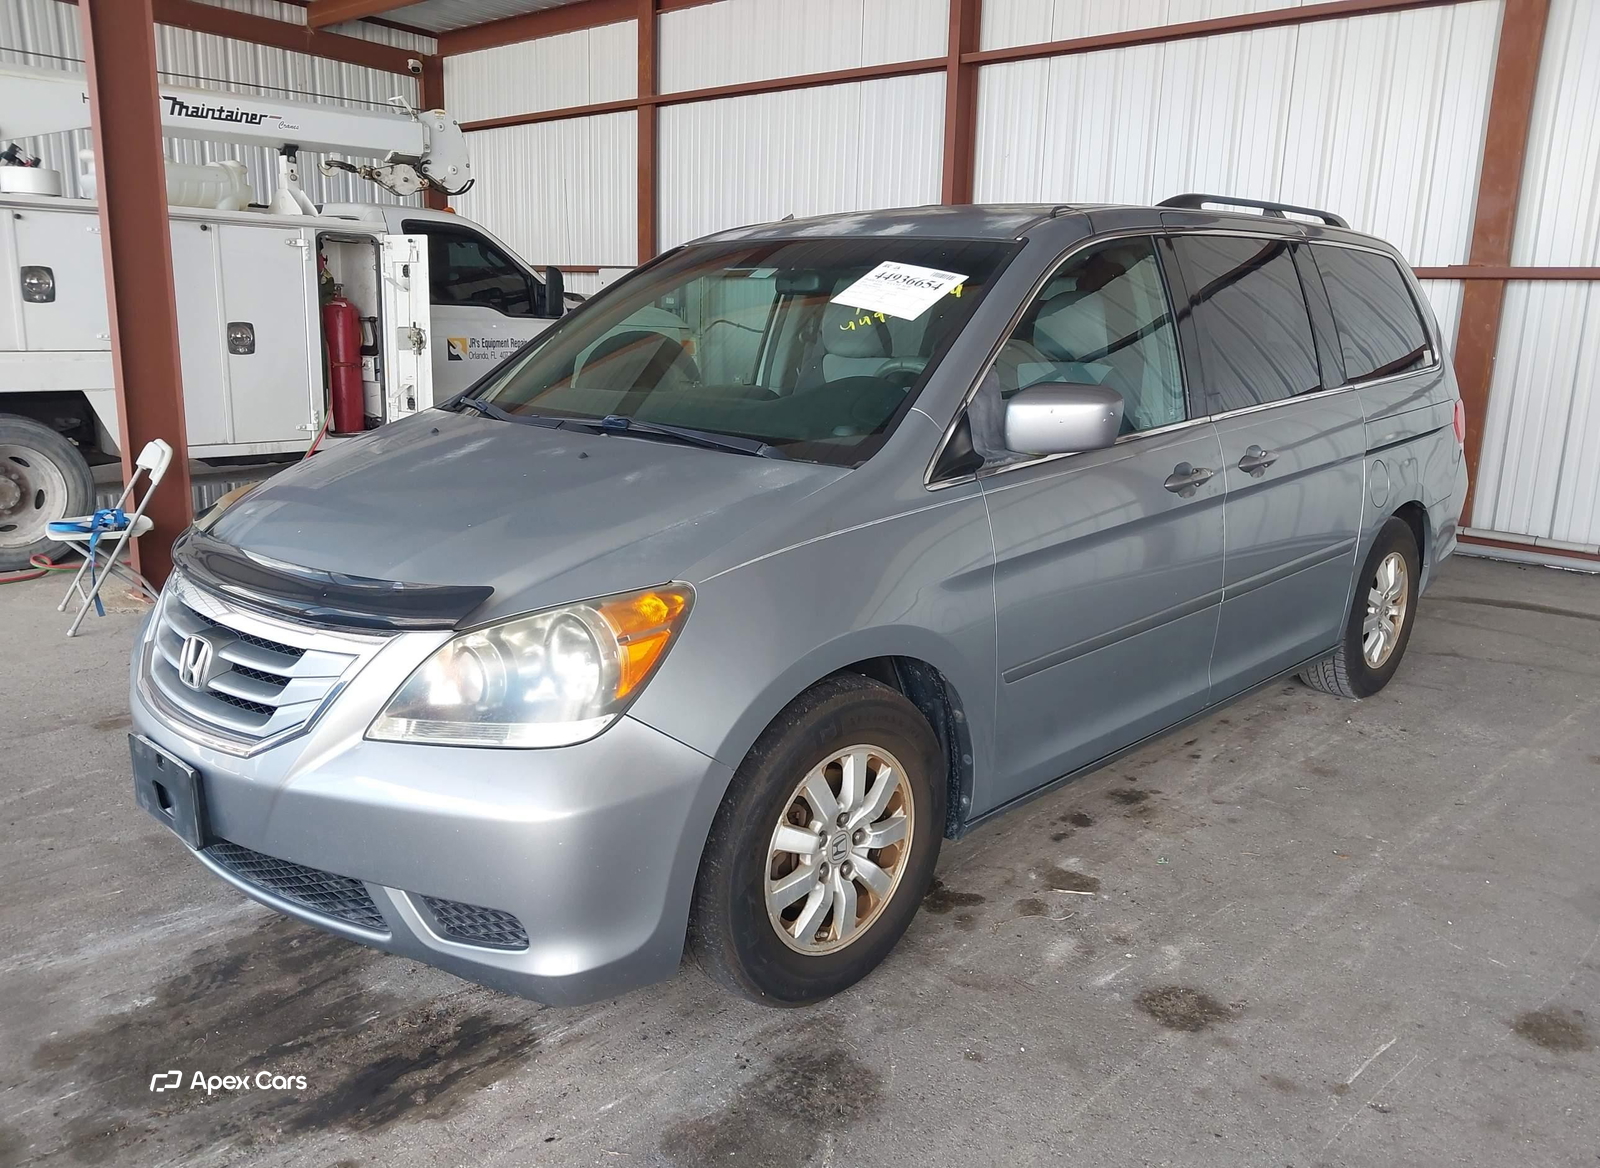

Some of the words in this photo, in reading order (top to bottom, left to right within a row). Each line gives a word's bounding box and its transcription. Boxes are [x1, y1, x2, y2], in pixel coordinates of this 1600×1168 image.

[162, 96, 269, 125] Maintainer
[874, 271, 944, 291] 44936654
[468, 338, 480, 348] JR's
[481, 338, 510, 351] Equipment
[490, 351, 497, 360] FL
